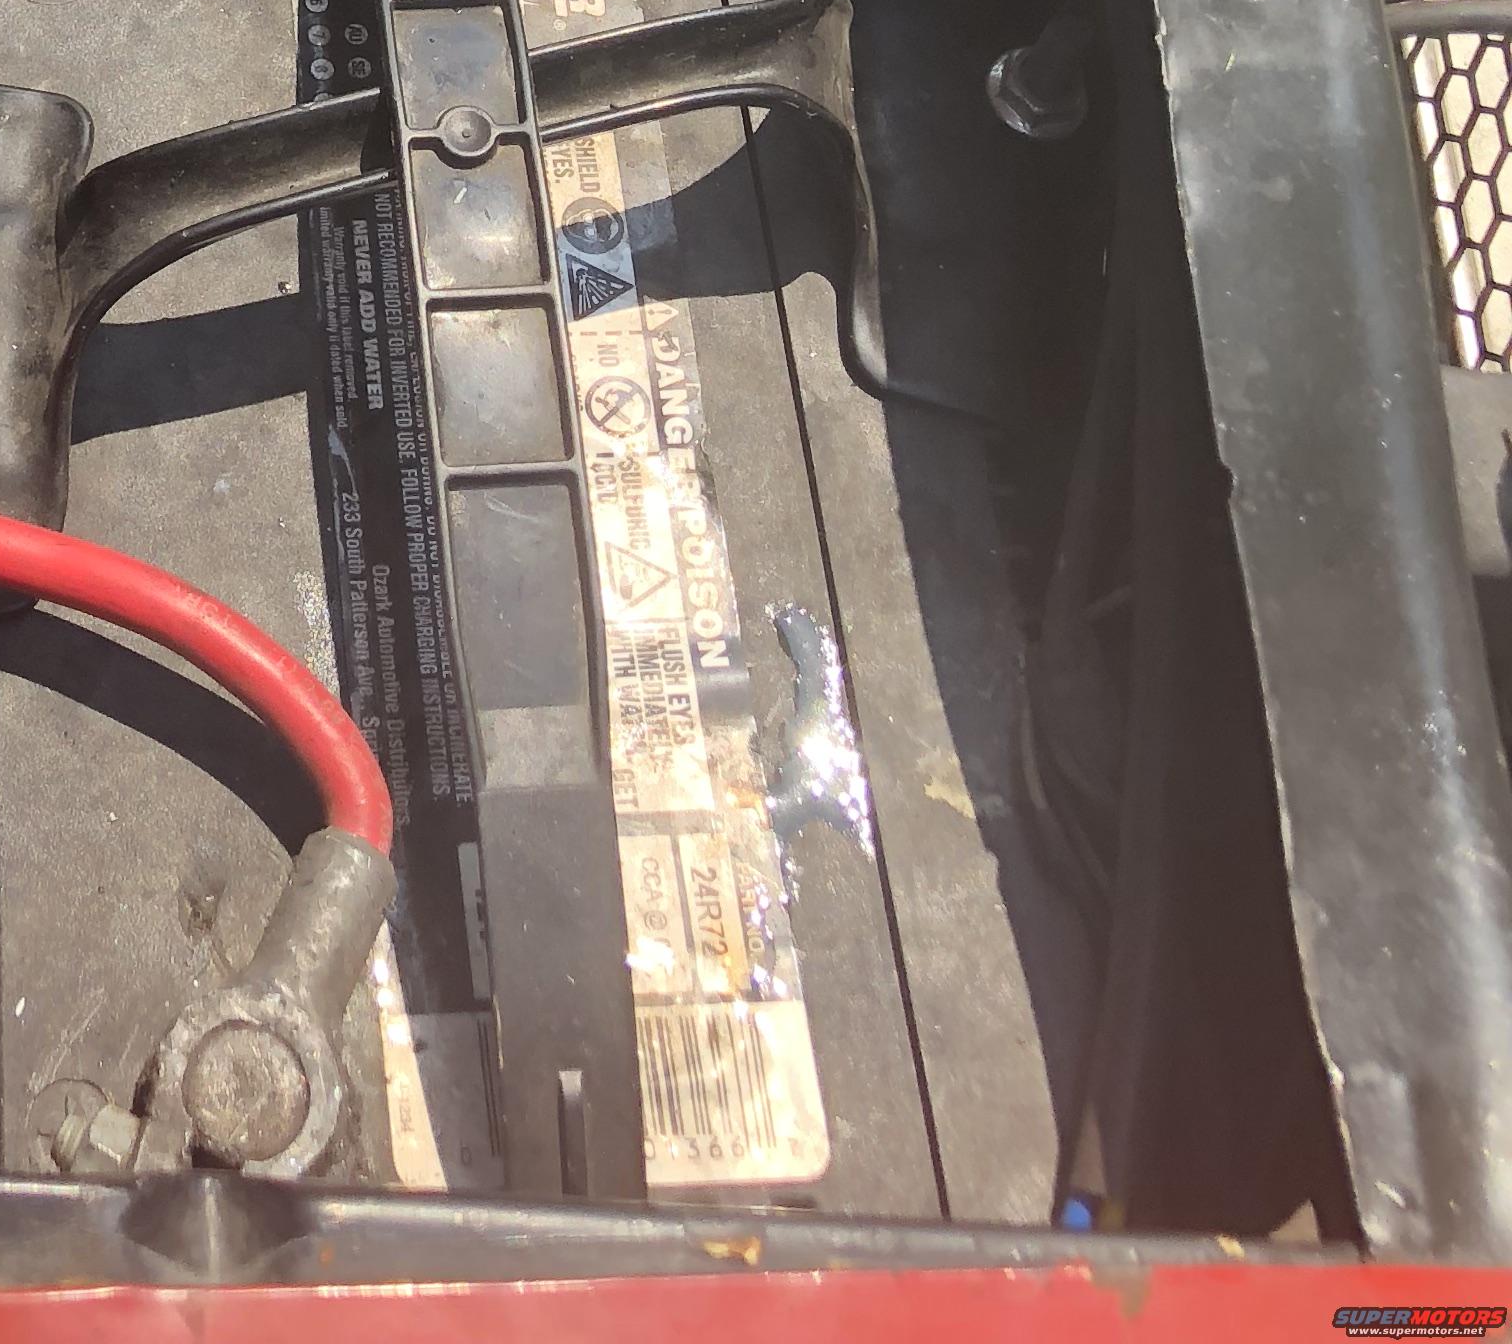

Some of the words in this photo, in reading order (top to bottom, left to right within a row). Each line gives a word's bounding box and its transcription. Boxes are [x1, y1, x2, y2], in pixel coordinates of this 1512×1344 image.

[574, 137, 601, 192] SHIELD
[374, 193, 392, 219] NOT
[351, 219, 372, 284] NEVER
[376, 223, 402, 325] RECOMMENDED
[336, 272, 349, 293] void
[359, 289, 377, 333] ADD
[326, 311, 339, 332] only
[333, 375, 345, 403] when
[387, 329, 407, 356] FOR
[596, 344, 620, 368] NO
[362, 338, 384, 410] WATER
[390, 360, 413, 428] INVERTED
[396, 432, 416, 464] USE.
[342, 492, 361, 522] 233
[400, 468, 423, 529] FOLLOW
[345, 527, 366, 574] South
[405, 532, 429, 592] PROPER
[372, 564, 392, 612] Ozark
[349, 580, 371, 660] Patterson
[412, 596, 437, 674] CHARGING
[376, 616, 401, 713] Automotive
[658, 627, 688, 686] FLUSH
[420, 678, 450, 801] INSTRUCTIONS.
[668, 694, 697, 746] EYES
[613, 768, 639, 808] GET
[641, 856, 664, 904] CCA
[690, 866, 729, 957] 24R72
